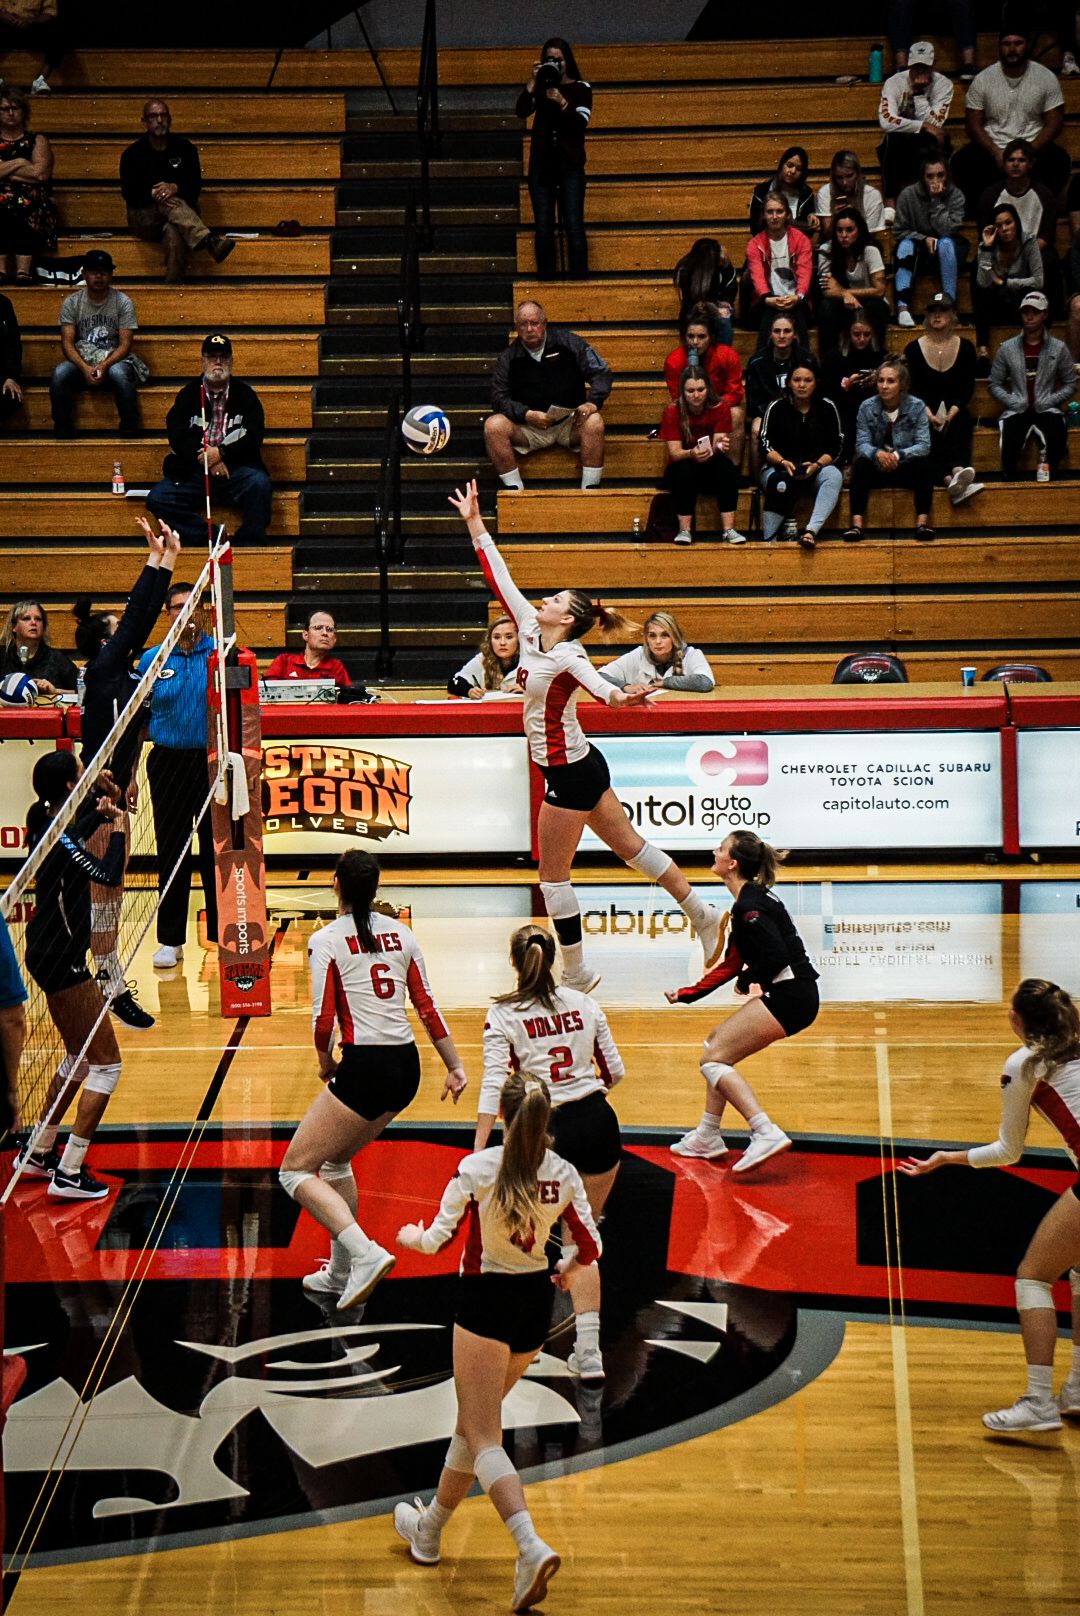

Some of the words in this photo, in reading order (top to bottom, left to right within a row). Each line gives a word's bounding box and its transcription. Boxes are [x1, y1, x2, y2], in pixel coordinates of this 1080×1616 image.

[258, 745, 411, 794] STERN
[781, 764, 858, 774] CHEVROLET
[866, 763, 931, 773] CADILLAC
[938, 763, 991, 773] SUBARU
[829, 777, 882, 786] TOYOTA
[893, 776, 934, 786] SCION
[262, 777, 411, 832] EGON
[620, 793, 695, 826] itol
[701, 794, 752, 811] auto
[822, 796, 950, 814] capitolauto.com
[265, 816, 369, 835] OLVES
[701, 812, 771, 831] group
[234, 868, 247, 906] sports
[236, 908, 249, 955] imports
[370, 964, 396, 999] 6
[522, 1010, 584, 1039] WOLVES
[547, 1046, 576, 1083] 2
